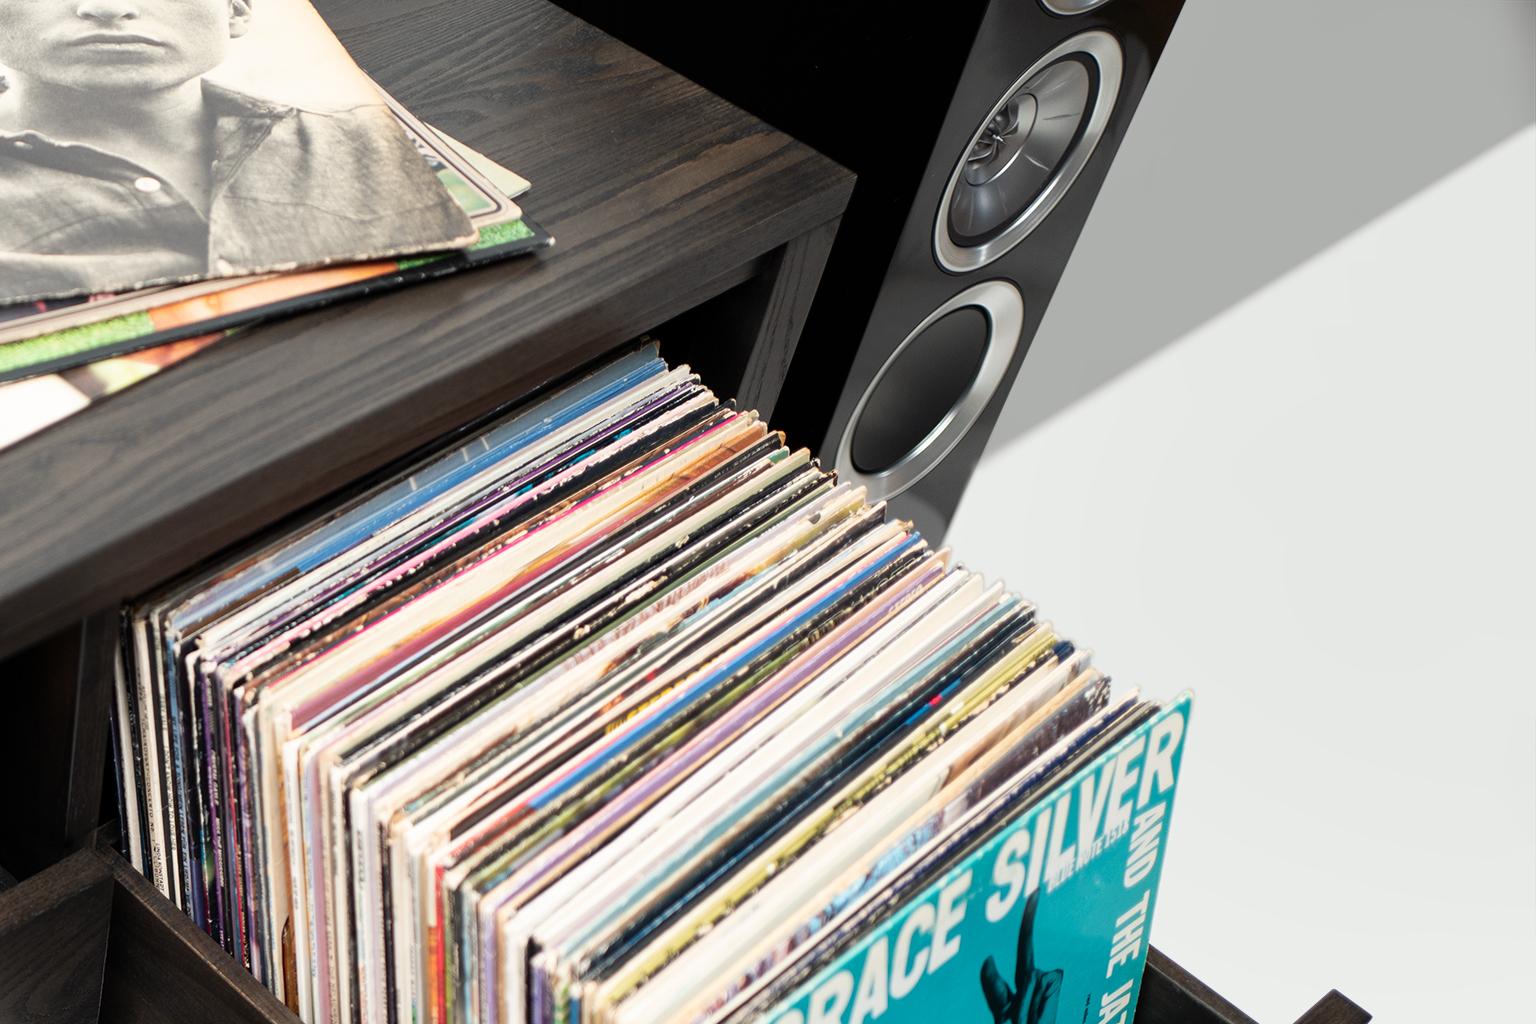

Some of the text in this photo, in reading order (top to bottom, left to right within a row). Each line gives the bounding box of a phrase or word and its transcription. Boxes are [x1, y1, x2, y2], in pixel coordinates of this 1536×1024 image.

[985, 714, 1184, 923] SILVER
[1123, 801, 1167, 889] AND
[1106, 889, 1150, 979] THE
